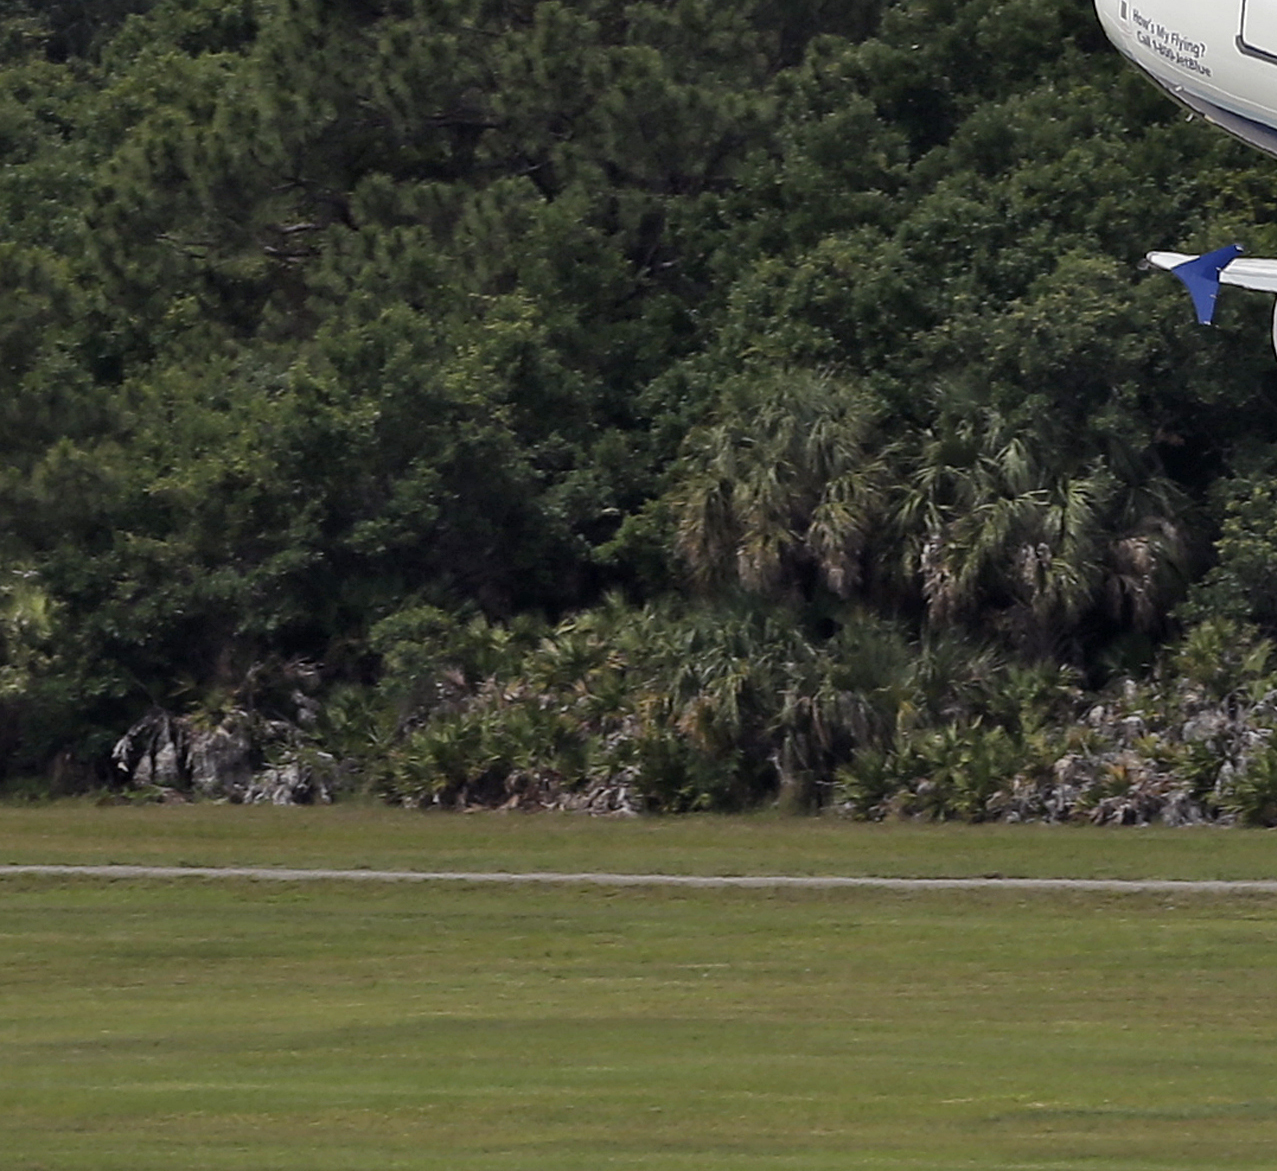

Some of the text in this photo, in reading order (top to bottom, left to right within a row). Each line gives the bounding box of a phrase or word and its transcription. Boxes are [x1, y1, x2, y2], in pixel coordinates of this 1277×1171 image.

[1137, 30, 1151, 48] Call
[1156, 23, 1170, 44] My
[1171, 32, 1206, 59] Flying?
